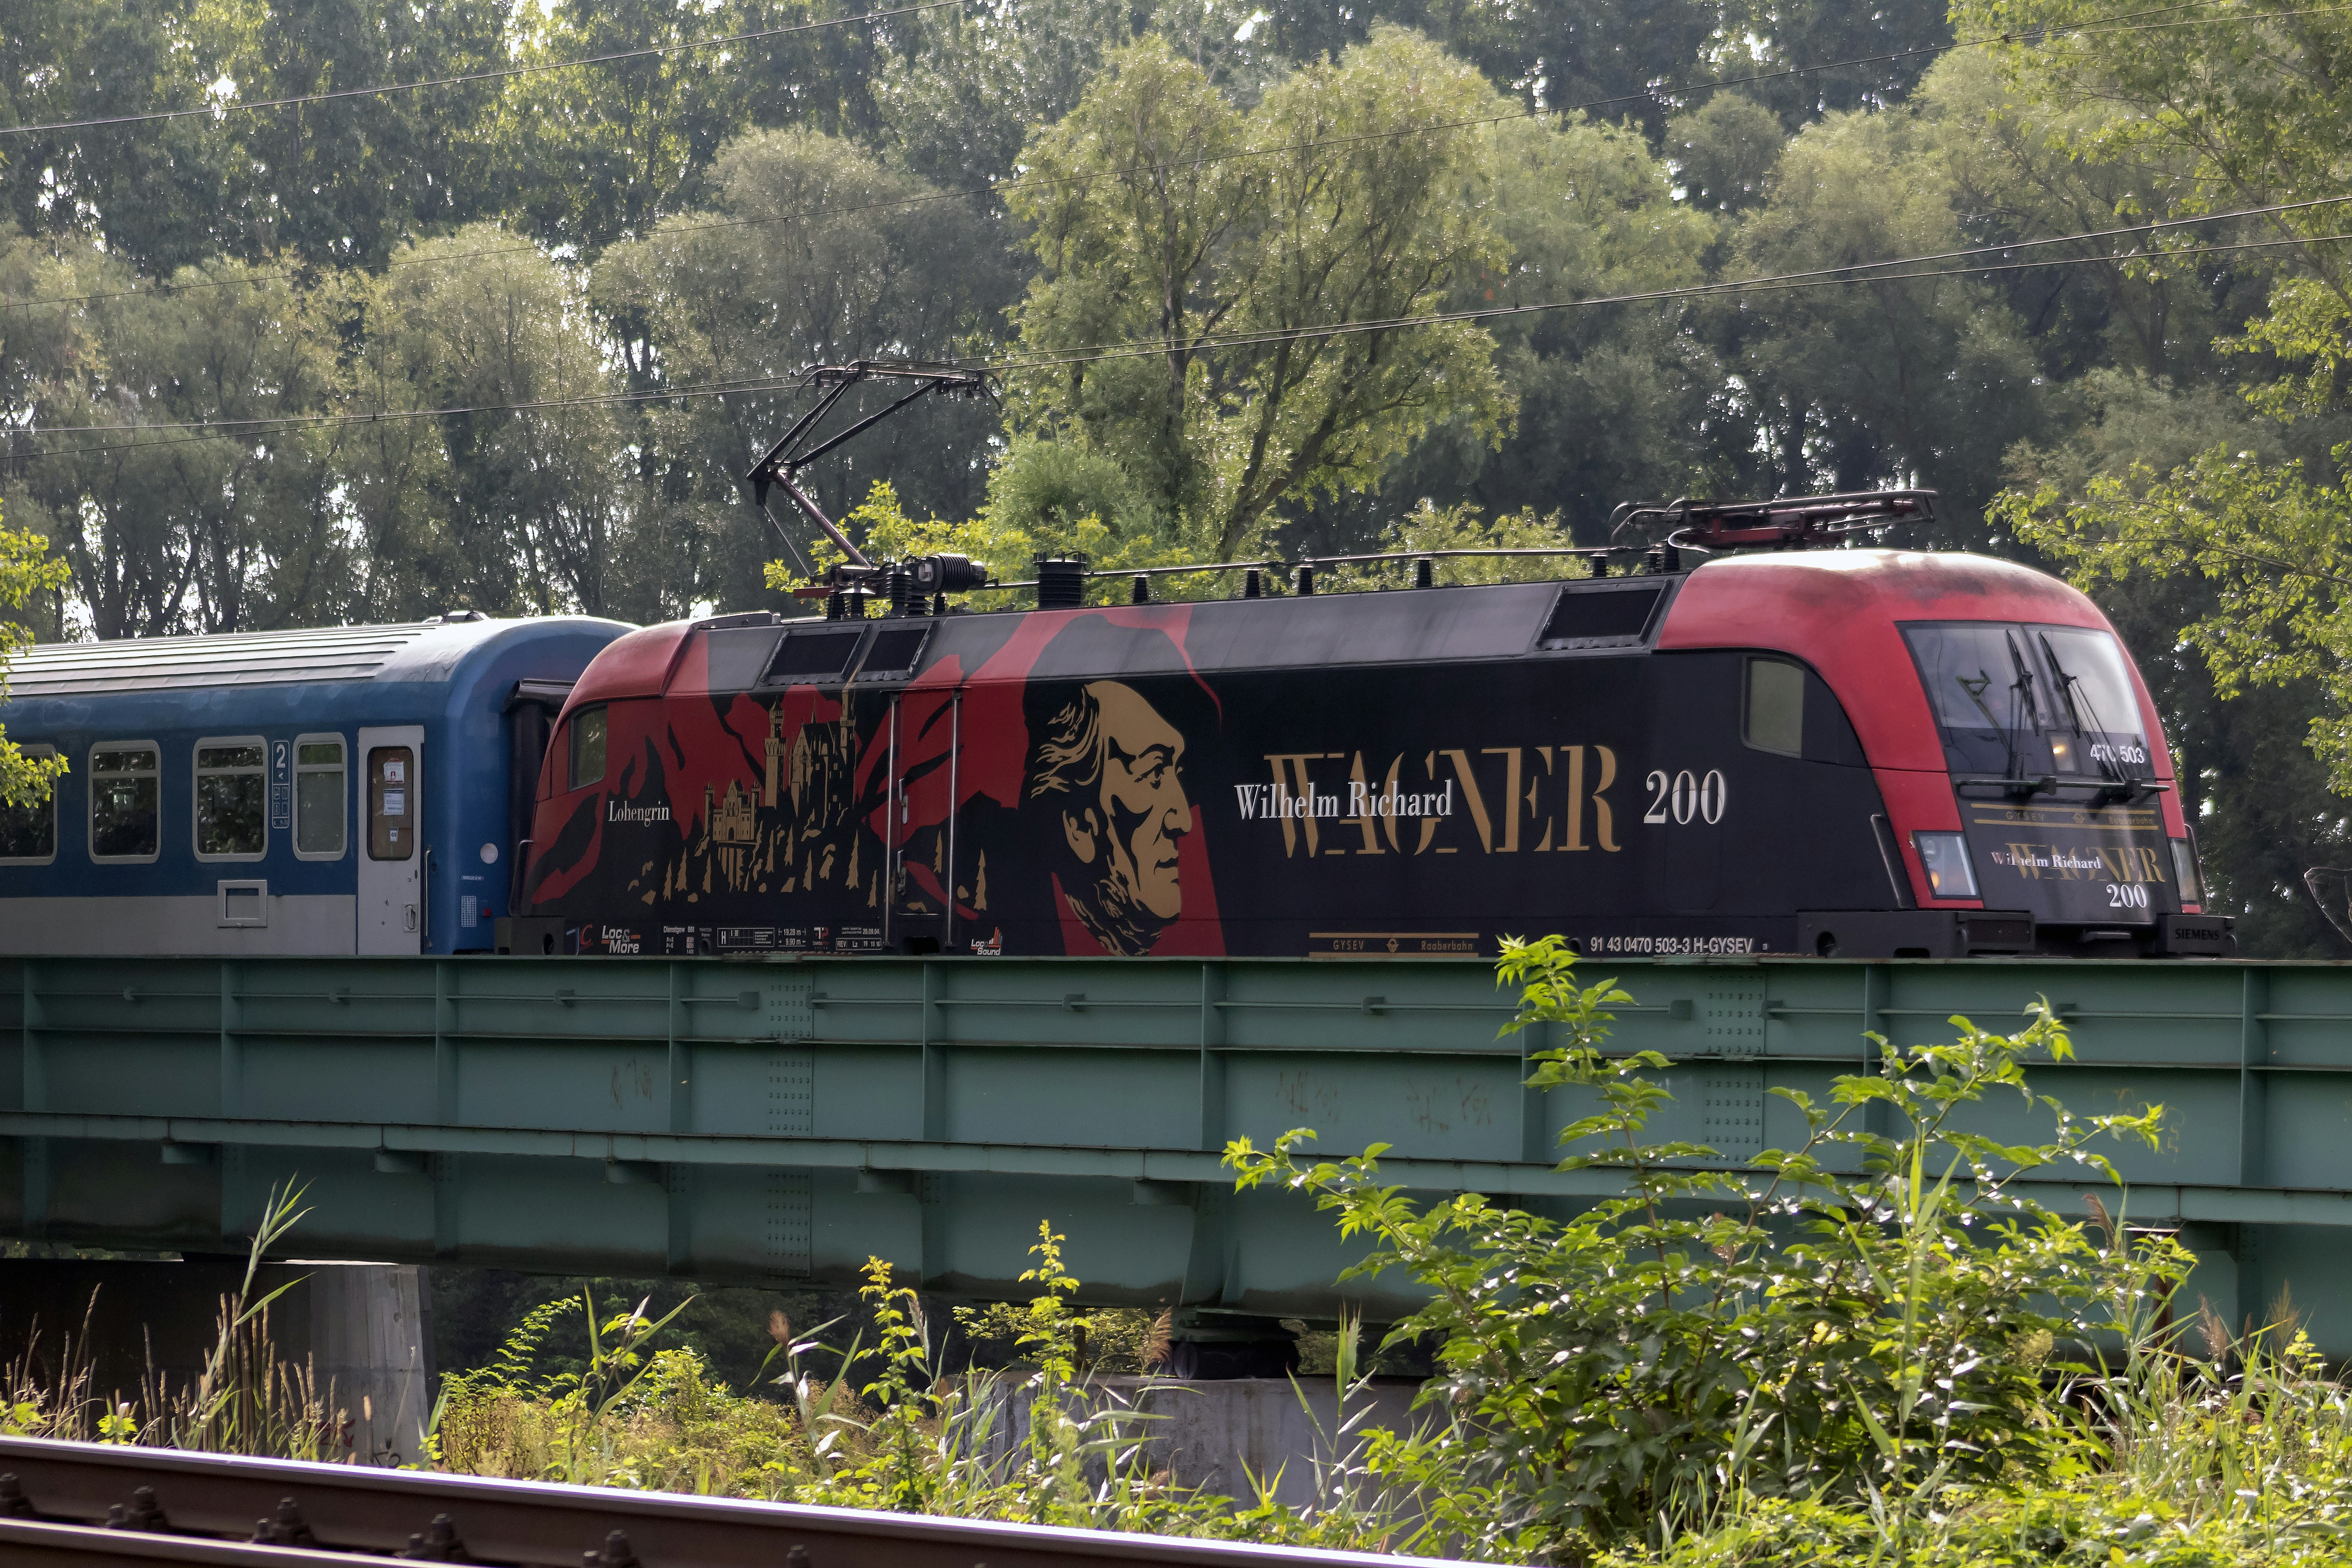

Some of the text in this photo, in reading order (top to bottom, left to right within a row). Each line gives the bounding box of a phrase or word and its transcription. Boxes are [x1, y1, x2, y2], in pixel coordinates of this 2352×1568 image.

[276, 744, 286, 768] 2
[2119, 745, 2144, 764] 503
[1234, 779, 1452, 820] Wilhelm Richard
[1263, 745, 1622, 858] WAGNER
[1643, 769, 1726, 825] 200
[608, 800, 670, 828] Lohengrin
[2005, 811, 2045, 822] GYSEV
[1990, 852, 2102, 869] Wilhelm Richard
[2004, 843, 2166, 882] WAGNER
[2106, 884, 2147, 908] 200
[721, 931, 726, 945] H
[2175, 928, 2220, 941] SIEMENS
[608, 940, 639, 954] More
[977, 947, 1001, 956] Sound
[1333, 939, 1473, 951] GYSEV Raaberbahn
[1590, 937, 1754, 954] 91 43 0470 503-3 H-GYSEV
